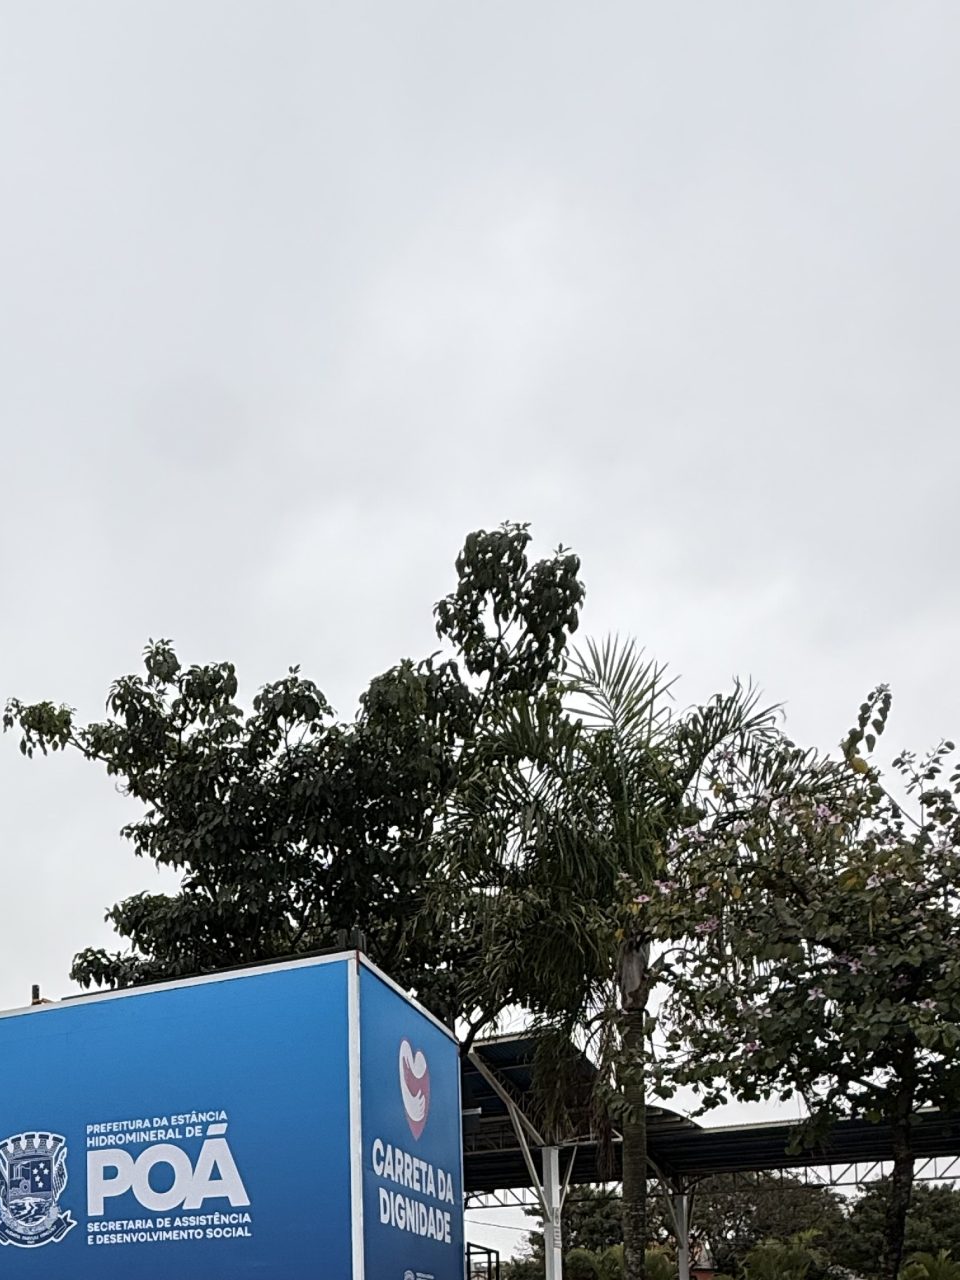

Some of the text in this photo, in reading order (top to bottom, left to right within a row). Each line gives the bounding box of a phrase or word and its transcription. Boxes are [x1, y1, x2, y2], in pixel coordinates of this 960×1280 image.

[86, 1110, 228, 1135] PREFEITURA DA ESTÂNCIA
[86, 1126, 203, 1148] HIDROMINERAL DE
[86, 1122, 251, 1217] POÁ
[372, 1138, 455, 1206] CARRETA DA
[86, 1211, 252, 1233] SECRETARIA DE ASSISTÊNCIA
[379, 1187, 451, 1244] DIGNIDADE
[87, 1226, 252, 1245] E DESENVOLVIMENTO SOCIAL
